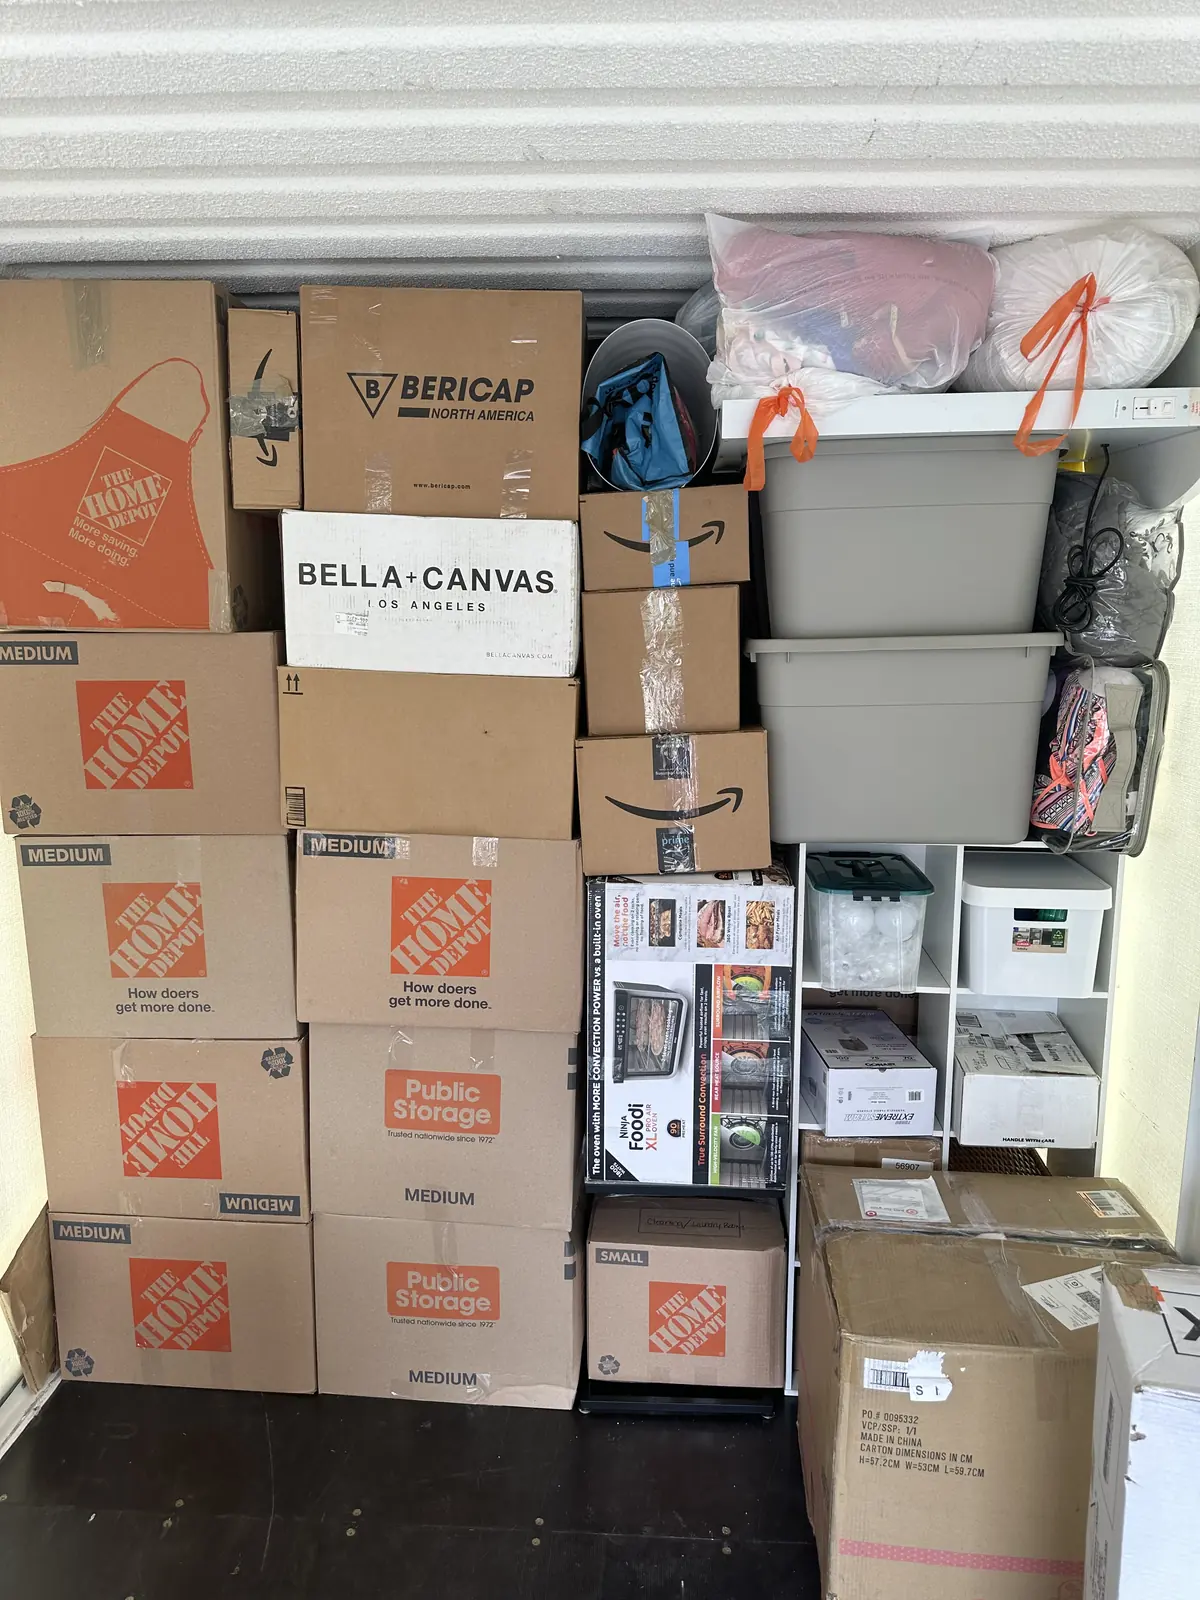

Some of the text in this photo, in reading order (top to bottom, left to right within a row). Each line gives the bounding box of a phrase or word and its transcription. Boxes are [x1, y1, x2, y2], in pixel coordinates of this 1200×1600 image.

[366, 380, 380, 398] B
[401, 375, 534, 402] BERICAP
[431, 408, 534, 421] NORTH AMERICA
[100, 468, 134, 488] THE
[84, 475, 167, 519] HOME
[107, 502, 157, 530] DEPOT
[69, 528, 129, 567] More doing.
[73, 516, 138, 558] More saving.
[411, 601, 486, 612] ANGELES
[0, 646, 72, 661] MEDIUM
[89, 692, 133, 736] THE
[84, 680, 187, 789] HOME
[127, 721, 190, 789] DEPOT
[310, 838, 387, 854] MEDIUM
[662, 836, 689, 846] prime
[28, 848, 104, 862] MEDIUM
[115, 893, 155, 931] THE
[400, 888, 443, 926] THE
[110, 880, 201, 978] HOME
[391, 879, 492, 975] HOME
[148, 918, 204, 978] DEPOT
[430, 916, 491, 975] DEPOT
[593, 921, 601, 956] built-in
[128, 988, 199, 999] How doers
[404, 981, 477, 994] How doers
[593, 979, 601, 1015] POWER
[116, 1002, 214, 1014] get more done.
[389, 996, 490, 1009] get more done.
[593, 1017, 601, 1080] CONVECTION
[406, 1079, 480, 1102] Public
[120, 1082, 177, 1142] DEPOT
[394, 1099, 491, 1129] Storage
[697, 1053, 707, 1166] True Surround Convection
[122, 1083, 217, 1177] HOME
[592, 1112, 601, 1133] with
[619, 1116, 630, 1138] NINJA
[628, 1104, 643, 1150] Foodi
[670, 1123, 677, 1134] 90
[387, 1130, 412, 1138] Trusted
[415, 1133, 455, 1141] nationwide
[646, 1133, 657, 1151] XL
[170, 1131, 211, 1169] THE
[592, 1158, 601, 1174] The
[610, 1164, 622, 1177] 1800
[895, 1162, 920, 1171] 56907
[225, 1197, 294, 1212] MEDIUM
[405, 1188, 474, 1205] MEDIUM
[59, 1225, 126, 1240] MEDIUM
[601, 1251, 644, 1263] SMALL
[140, 1269, 180, 1304] THE
[407, 1271, 479, 1292] Public
[135, 1261, 227, 1348] HOME
[396, 1289, 491, 1316] Storage
[656, 1291, 688, 1320] THE
[172, 1296, 229, 1350] DEPOT
[417, 1318, 456, 1327] nationwide
[458, 1320, 476, 1328] since
[649, 1284, 726, 1353] HOME
[679, 1313, 726, 1355] DEPOT
[409, 1370, 477, 1385] MEDIUM
[915, 1386, 924, 1395] S
[862, 1421, 917, 1436] VCP/SSP: 1/1
[884, 1412, 919, 1424] 0095332
[860, 1432, 922, 1447] MADE IN CHINA
[860, 1443, 973, 1463] CARTON DIMENSIONS IN CM
[860, 1456, 984, 1477] H=57.2CM W=53CM L=59.7CM
